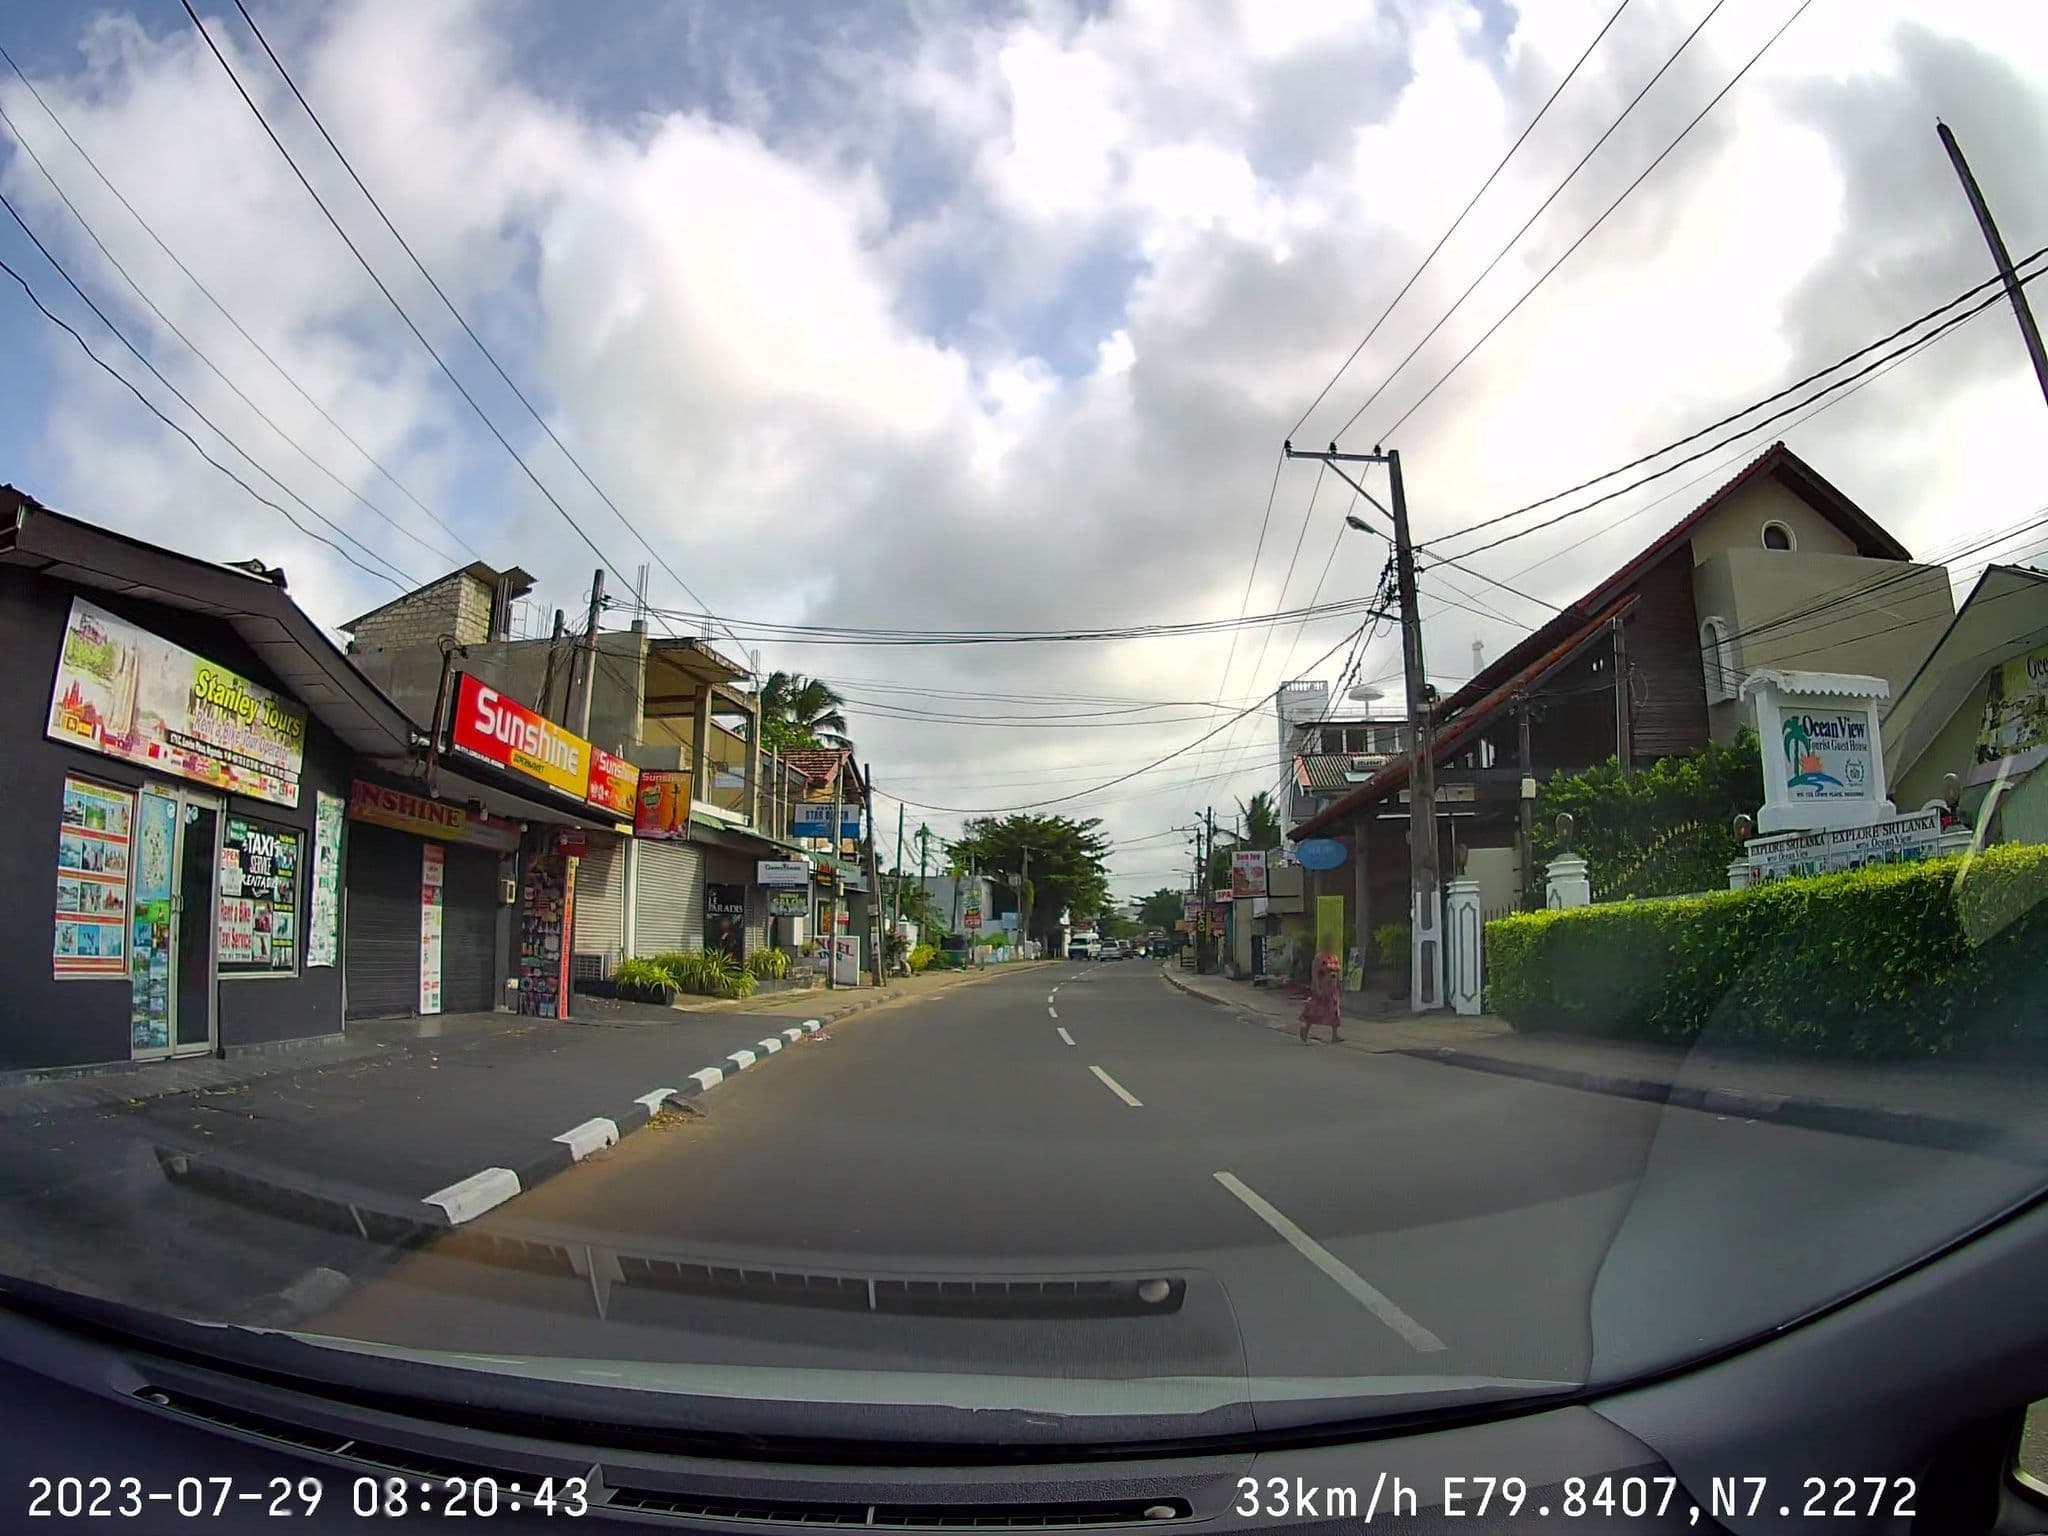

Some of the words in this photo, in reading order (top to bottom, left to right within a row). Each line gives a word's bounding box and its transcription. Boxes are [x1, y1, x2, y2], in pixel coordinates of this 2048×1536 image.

[194, 669, 261, 726] Stanley
[263, 696, 301, 737] Tours
[475, 687, 579, 776] Sunshine
[1803, 715, 1838, 739] Ocean
[1838, 716, 1866, 739] View
[1808, 738, 1830, 751] Tourist
[1832, 824, 1880, 845] EXPLORE
[1882, 820, 1900, 837] SRI
[1899, 815, 1936, 834] LANKA
[247, 831, 274, 857] TAXI
[1750, 842, 1784, 857] EXPLORE
[1799, 833, 1825, 849] LANKA
[1871, 837, 1893, 849] Ocean
